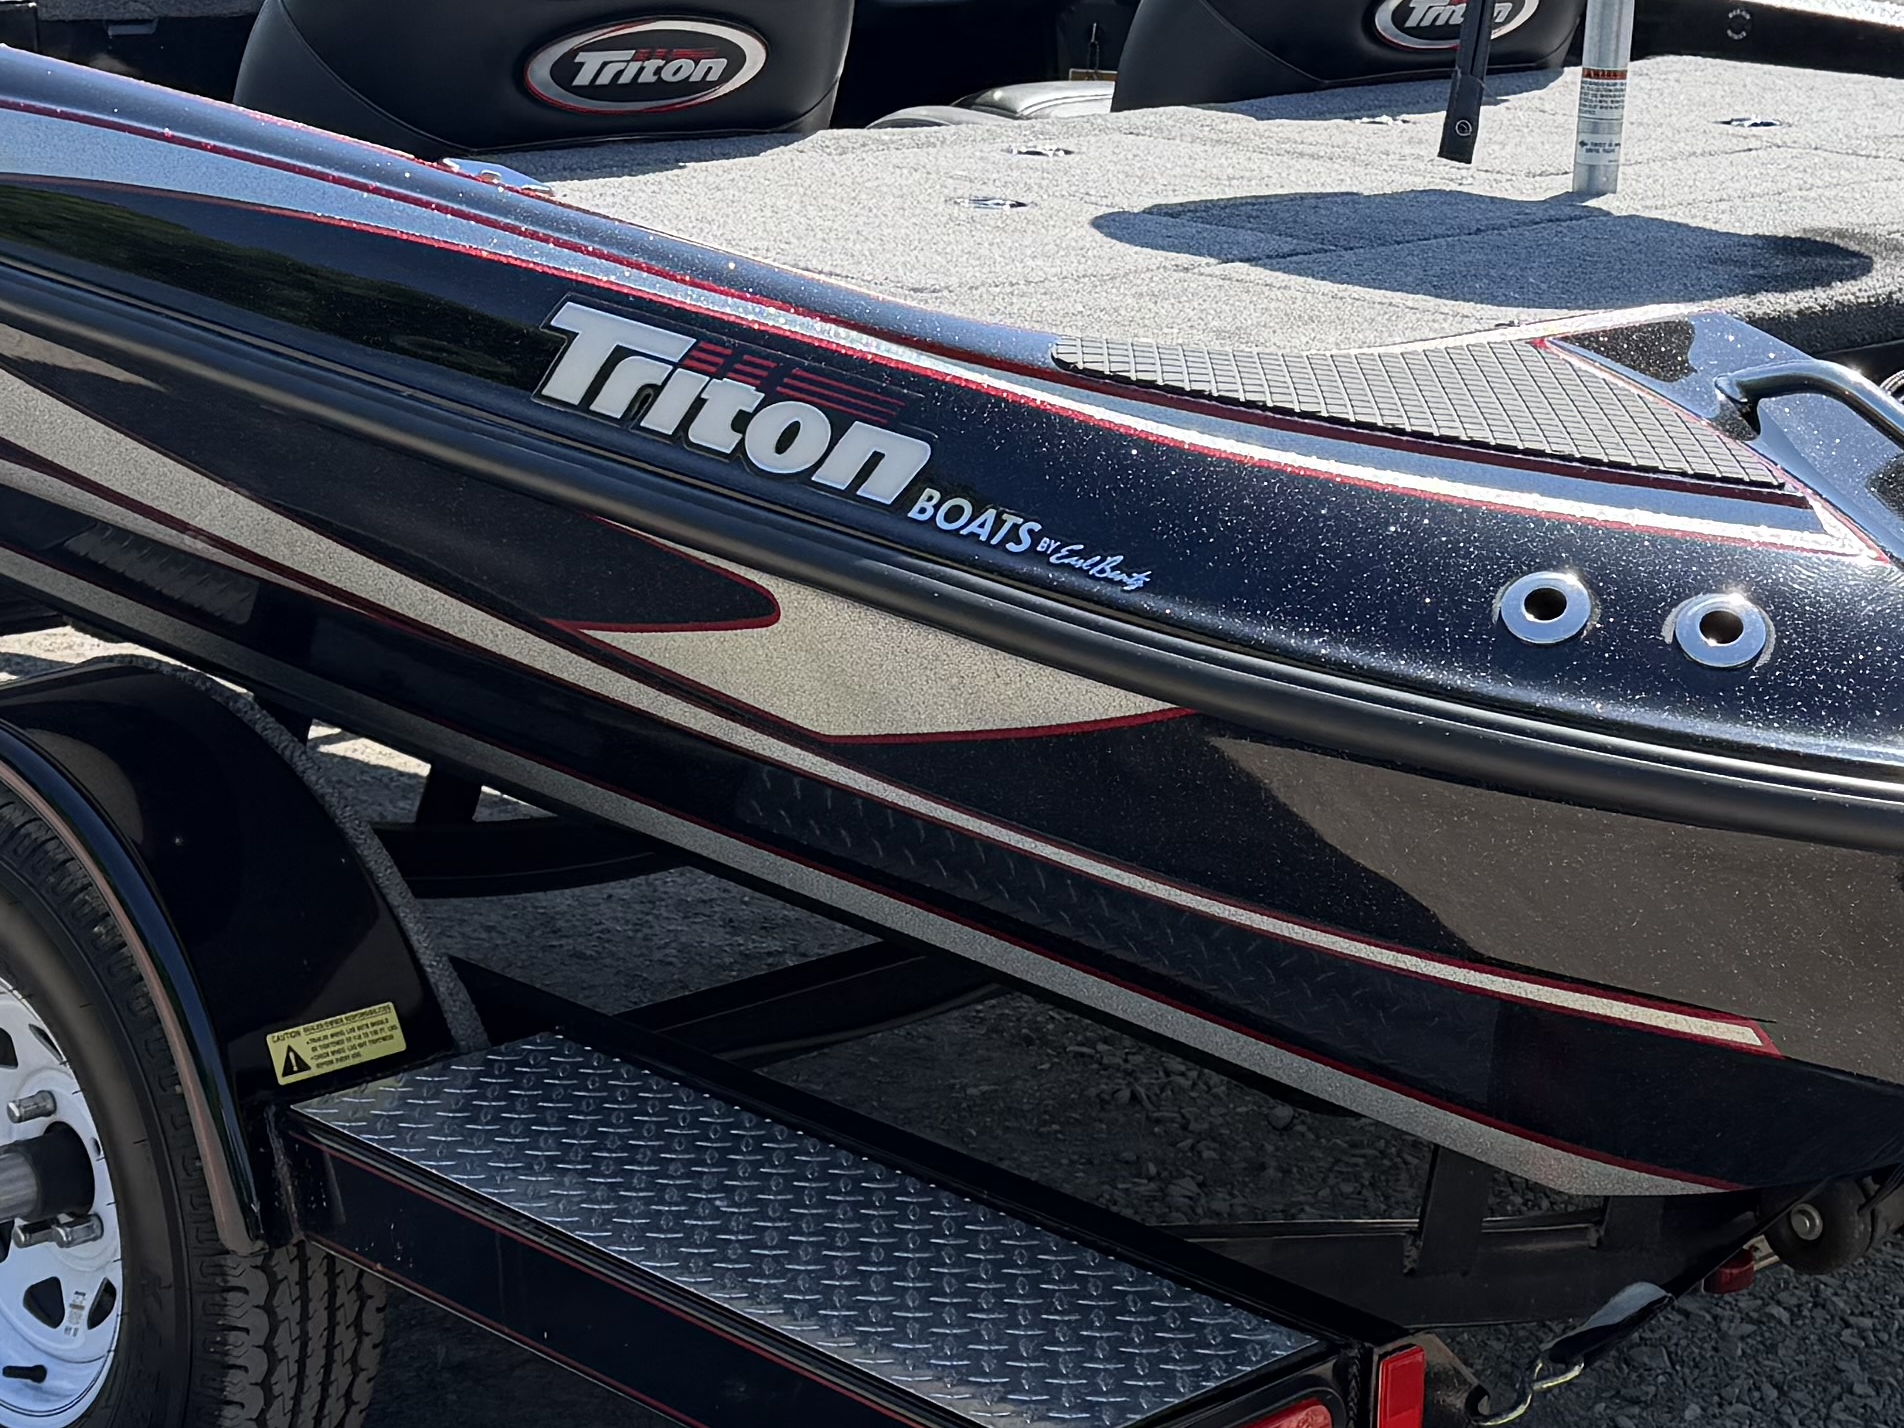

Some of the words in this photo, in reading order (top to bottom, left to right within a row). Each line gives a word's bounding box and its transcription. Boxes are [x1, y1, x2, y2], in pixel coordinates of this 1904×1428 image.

[571, 47, 729, 87] Triton
[539, 300, 933, 506] Triton
[907, 487, 1044, 554] BOATS
[1036, 536, 1062, 554] BY
